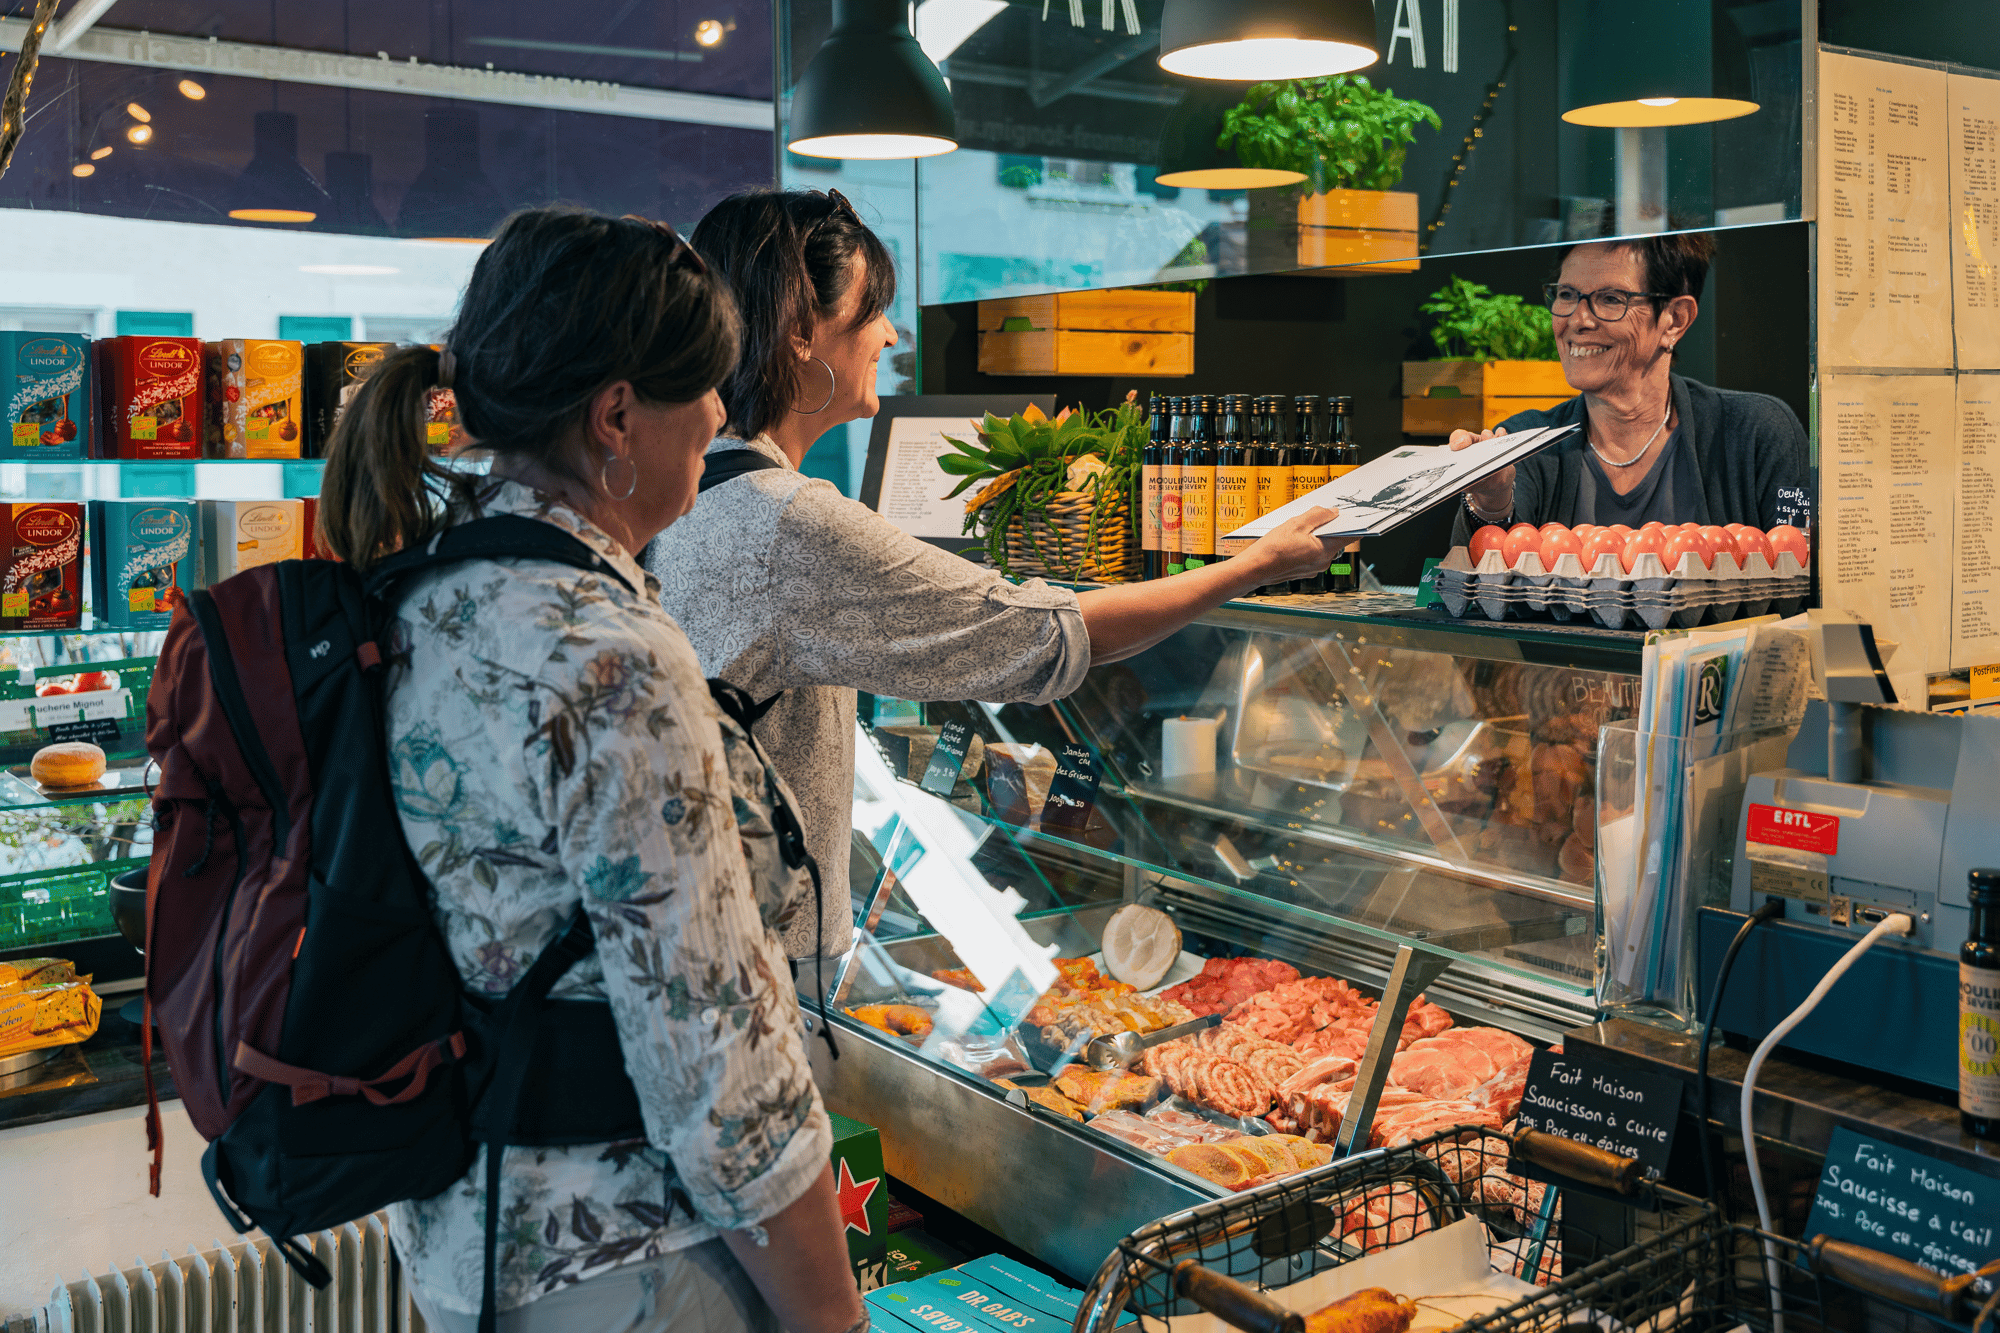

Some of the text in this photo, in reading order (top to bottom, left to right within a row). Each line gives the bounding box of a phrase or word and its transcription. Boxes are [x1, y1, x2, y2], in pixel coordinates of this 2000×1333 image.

[30, 358, 66, 366] LINDOR
[150, 361, 182, 369] LINDOR
[1293, 476, 1325, 484] MOULIN
[1778, 488, 1804, 502] Oeufs
[73, 700, 104, 710] Mignot
[944, 720, 966, 734] Viande
[1062, 745, 1090, 758] Jambon
[1056, 766, 1093, 782] des Grisons
[1774, 810, 1812, 828] ERTL
[1550, 1062, 1644, 1102] Fait Maison
[1524, 1085, 1602, 1122] Saucisson
[1607, 1112, 1617, 1127] à
[1546, 1118, 1568, 1138] Porc
[1596, 1136, 1640, 1159] épices
[1855, 1144, 1975, 1206] Fait Maison
[1822, 1164, 1920, 1222] Saucisse
[1928, 1214, 1942, 1230] à
[1855, 1210, 1886, 1236] Porc
[1922, 1242, 1977, 1275] épices
[956, 1290, 1036, 1328] DR. GAB'S
